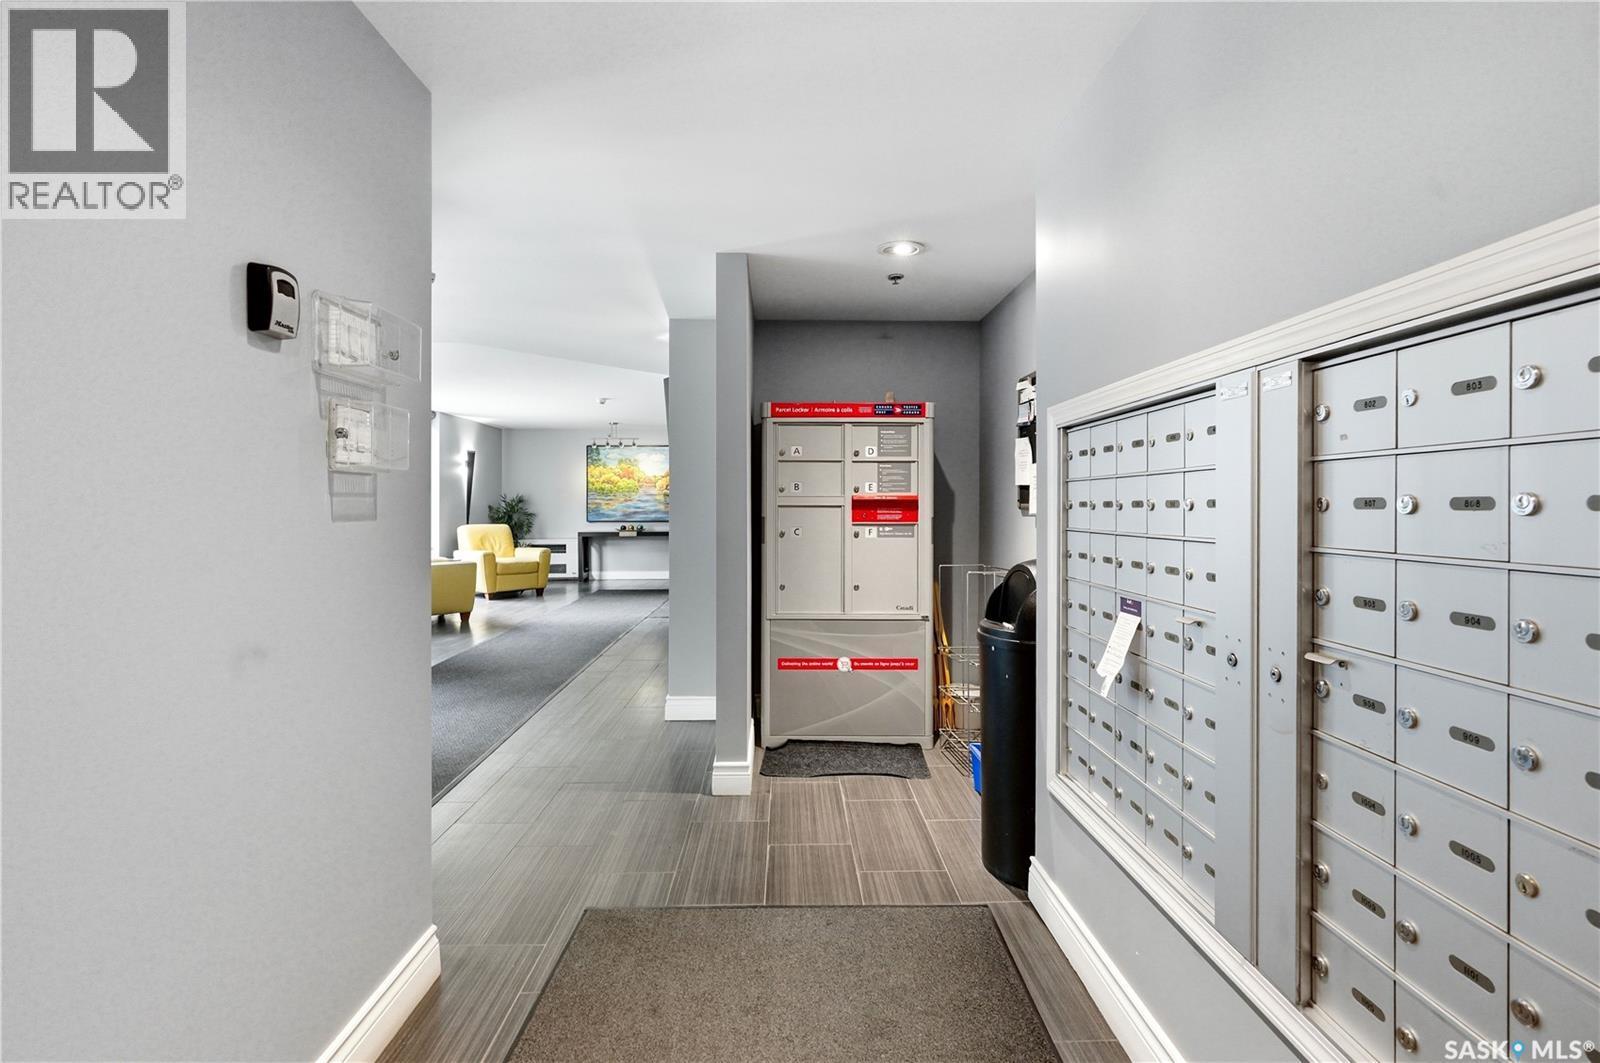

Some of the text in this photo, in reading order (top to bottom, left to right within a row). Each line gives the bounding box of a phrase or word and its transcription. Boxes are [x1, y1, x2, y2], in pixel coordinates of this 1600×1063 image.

[1466, 381, 1483, 391] 803
[1364, 400, 1377, 408] 802
[867, 447, 874, 455] D
[793, 483, 800, 491] B
[793, 528, 800, 536] C
[1464, 616, 1481, 626] 904
[1463, 732, 1480, 745] 909
[1461, 848, 1482, 865] 1005
[1463, 966, 1479, 982] 1101
